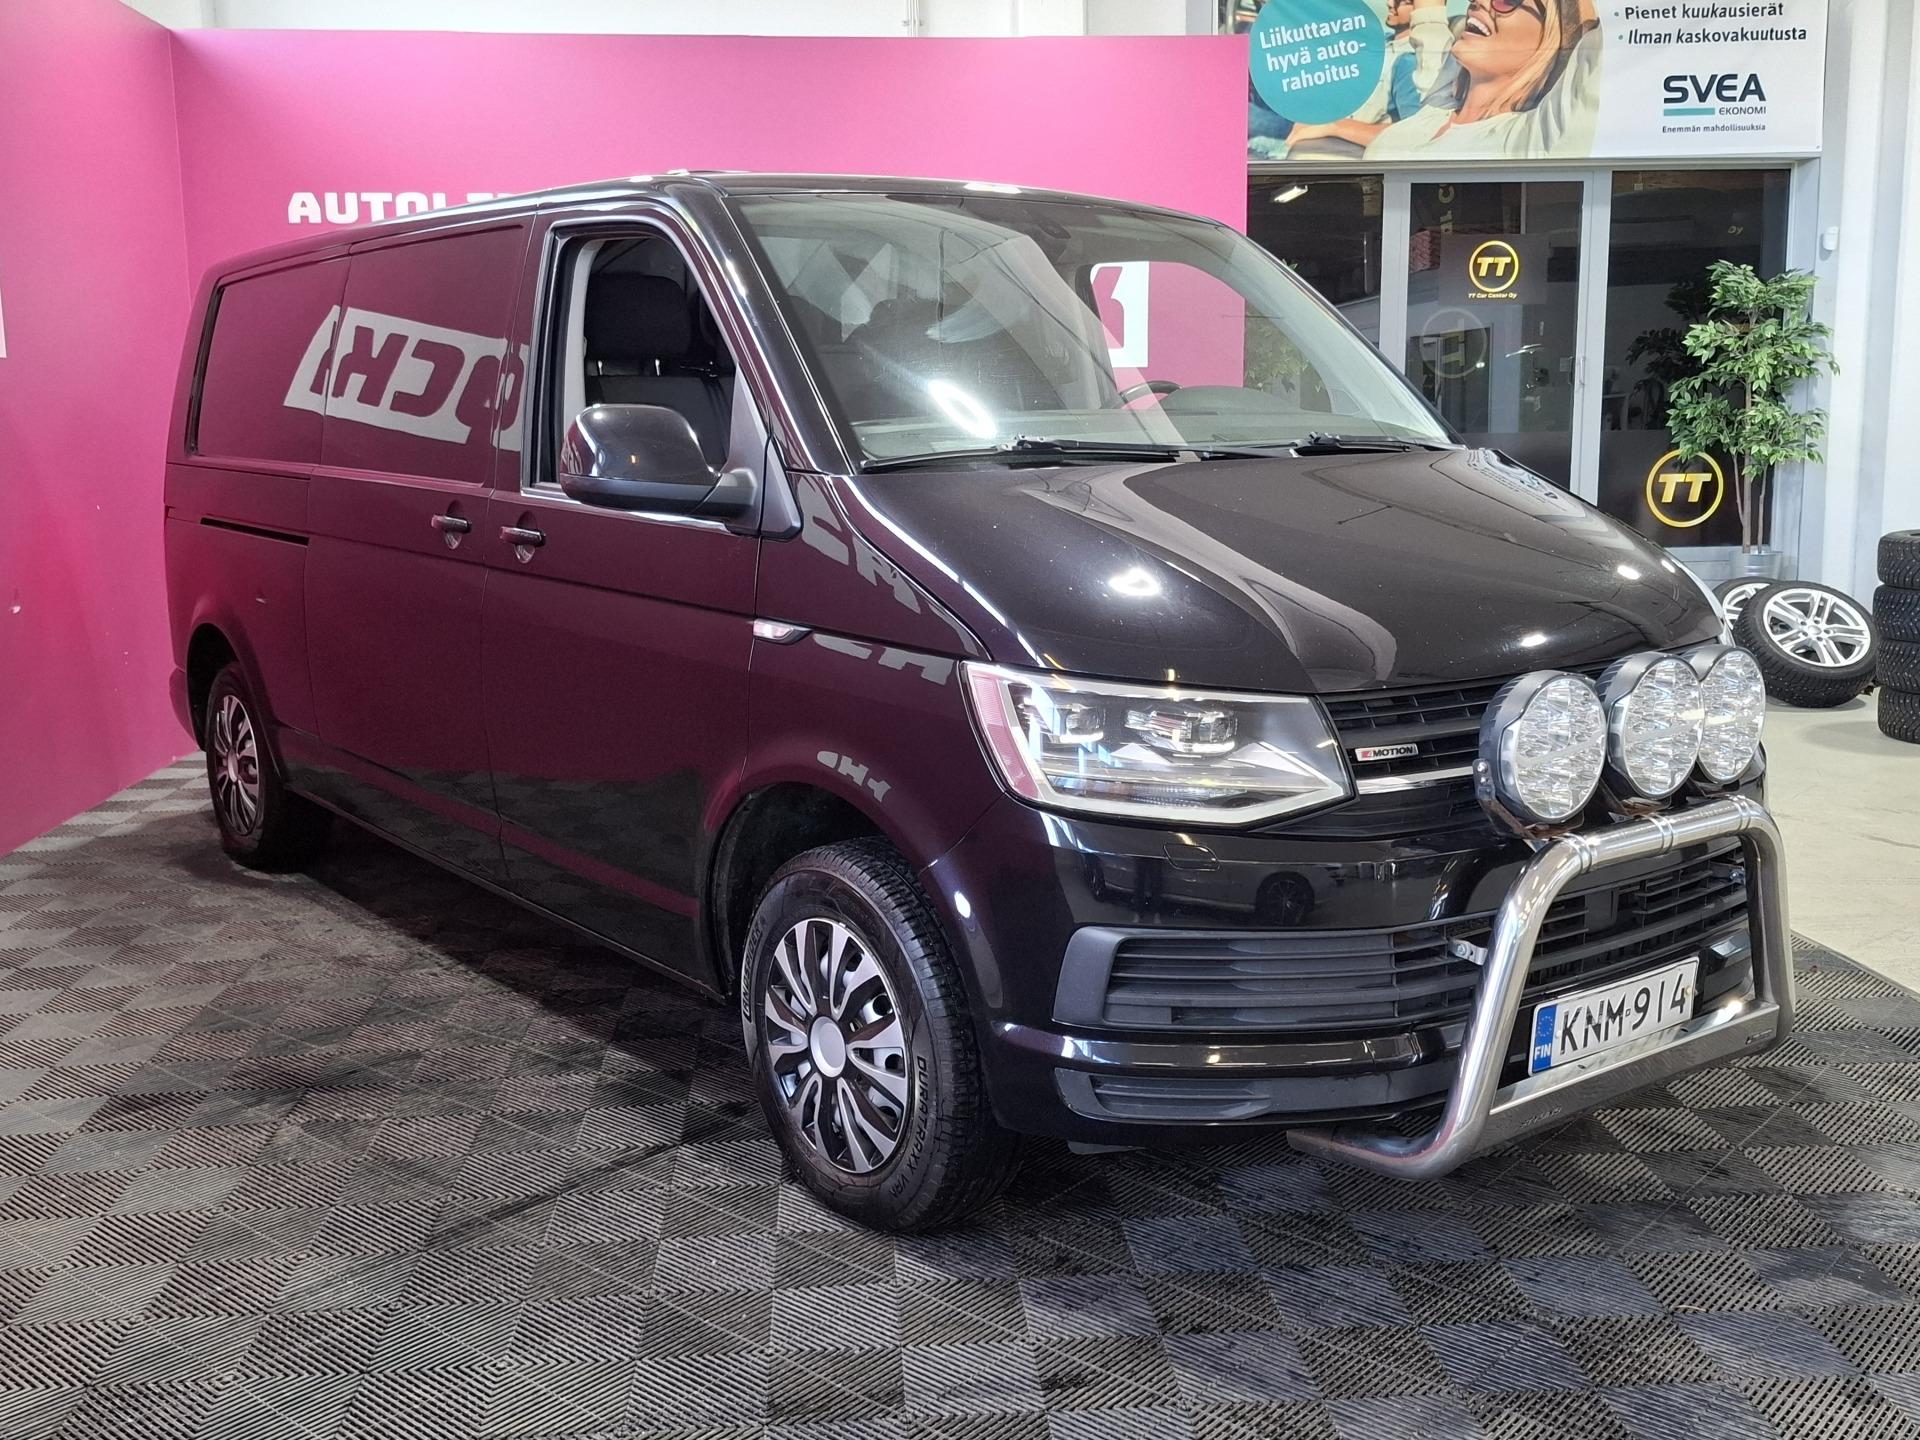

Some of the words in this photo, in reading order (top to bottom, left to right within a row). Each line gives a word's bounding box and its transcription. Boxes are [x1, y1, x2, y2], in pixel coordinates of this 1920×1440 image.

[1625, 6, 1677, 19] Pienet
[1682, 3, 1785, 18] kuukausierät
[1260, 14, 1366, 49] Liikuttavan
[1628, 29, 1672, 44] Ilman
[1676, 27, 1807, 43] kaskovakuutusta
[1266, 46, 1312, 73] hyvä
[1317, 40, 1366, 61] auto-
[1281, 63, 1360, 92] rahoitus
[1663, 74, 1767, 104] SVEA
[1719, 107, 1767, 116] EKONOMI
[1703, 124, 1766, 133] mahdollisuuksia
[1477, 257, 1511, 276] TT
[1658, 473, 1712, 503] TT
[1560, 973, 1686, 1055] KNM-914
[1534, 1043, 1552, 1060] FIN
[906, 1055, 929, 1172] DURATRAXX
